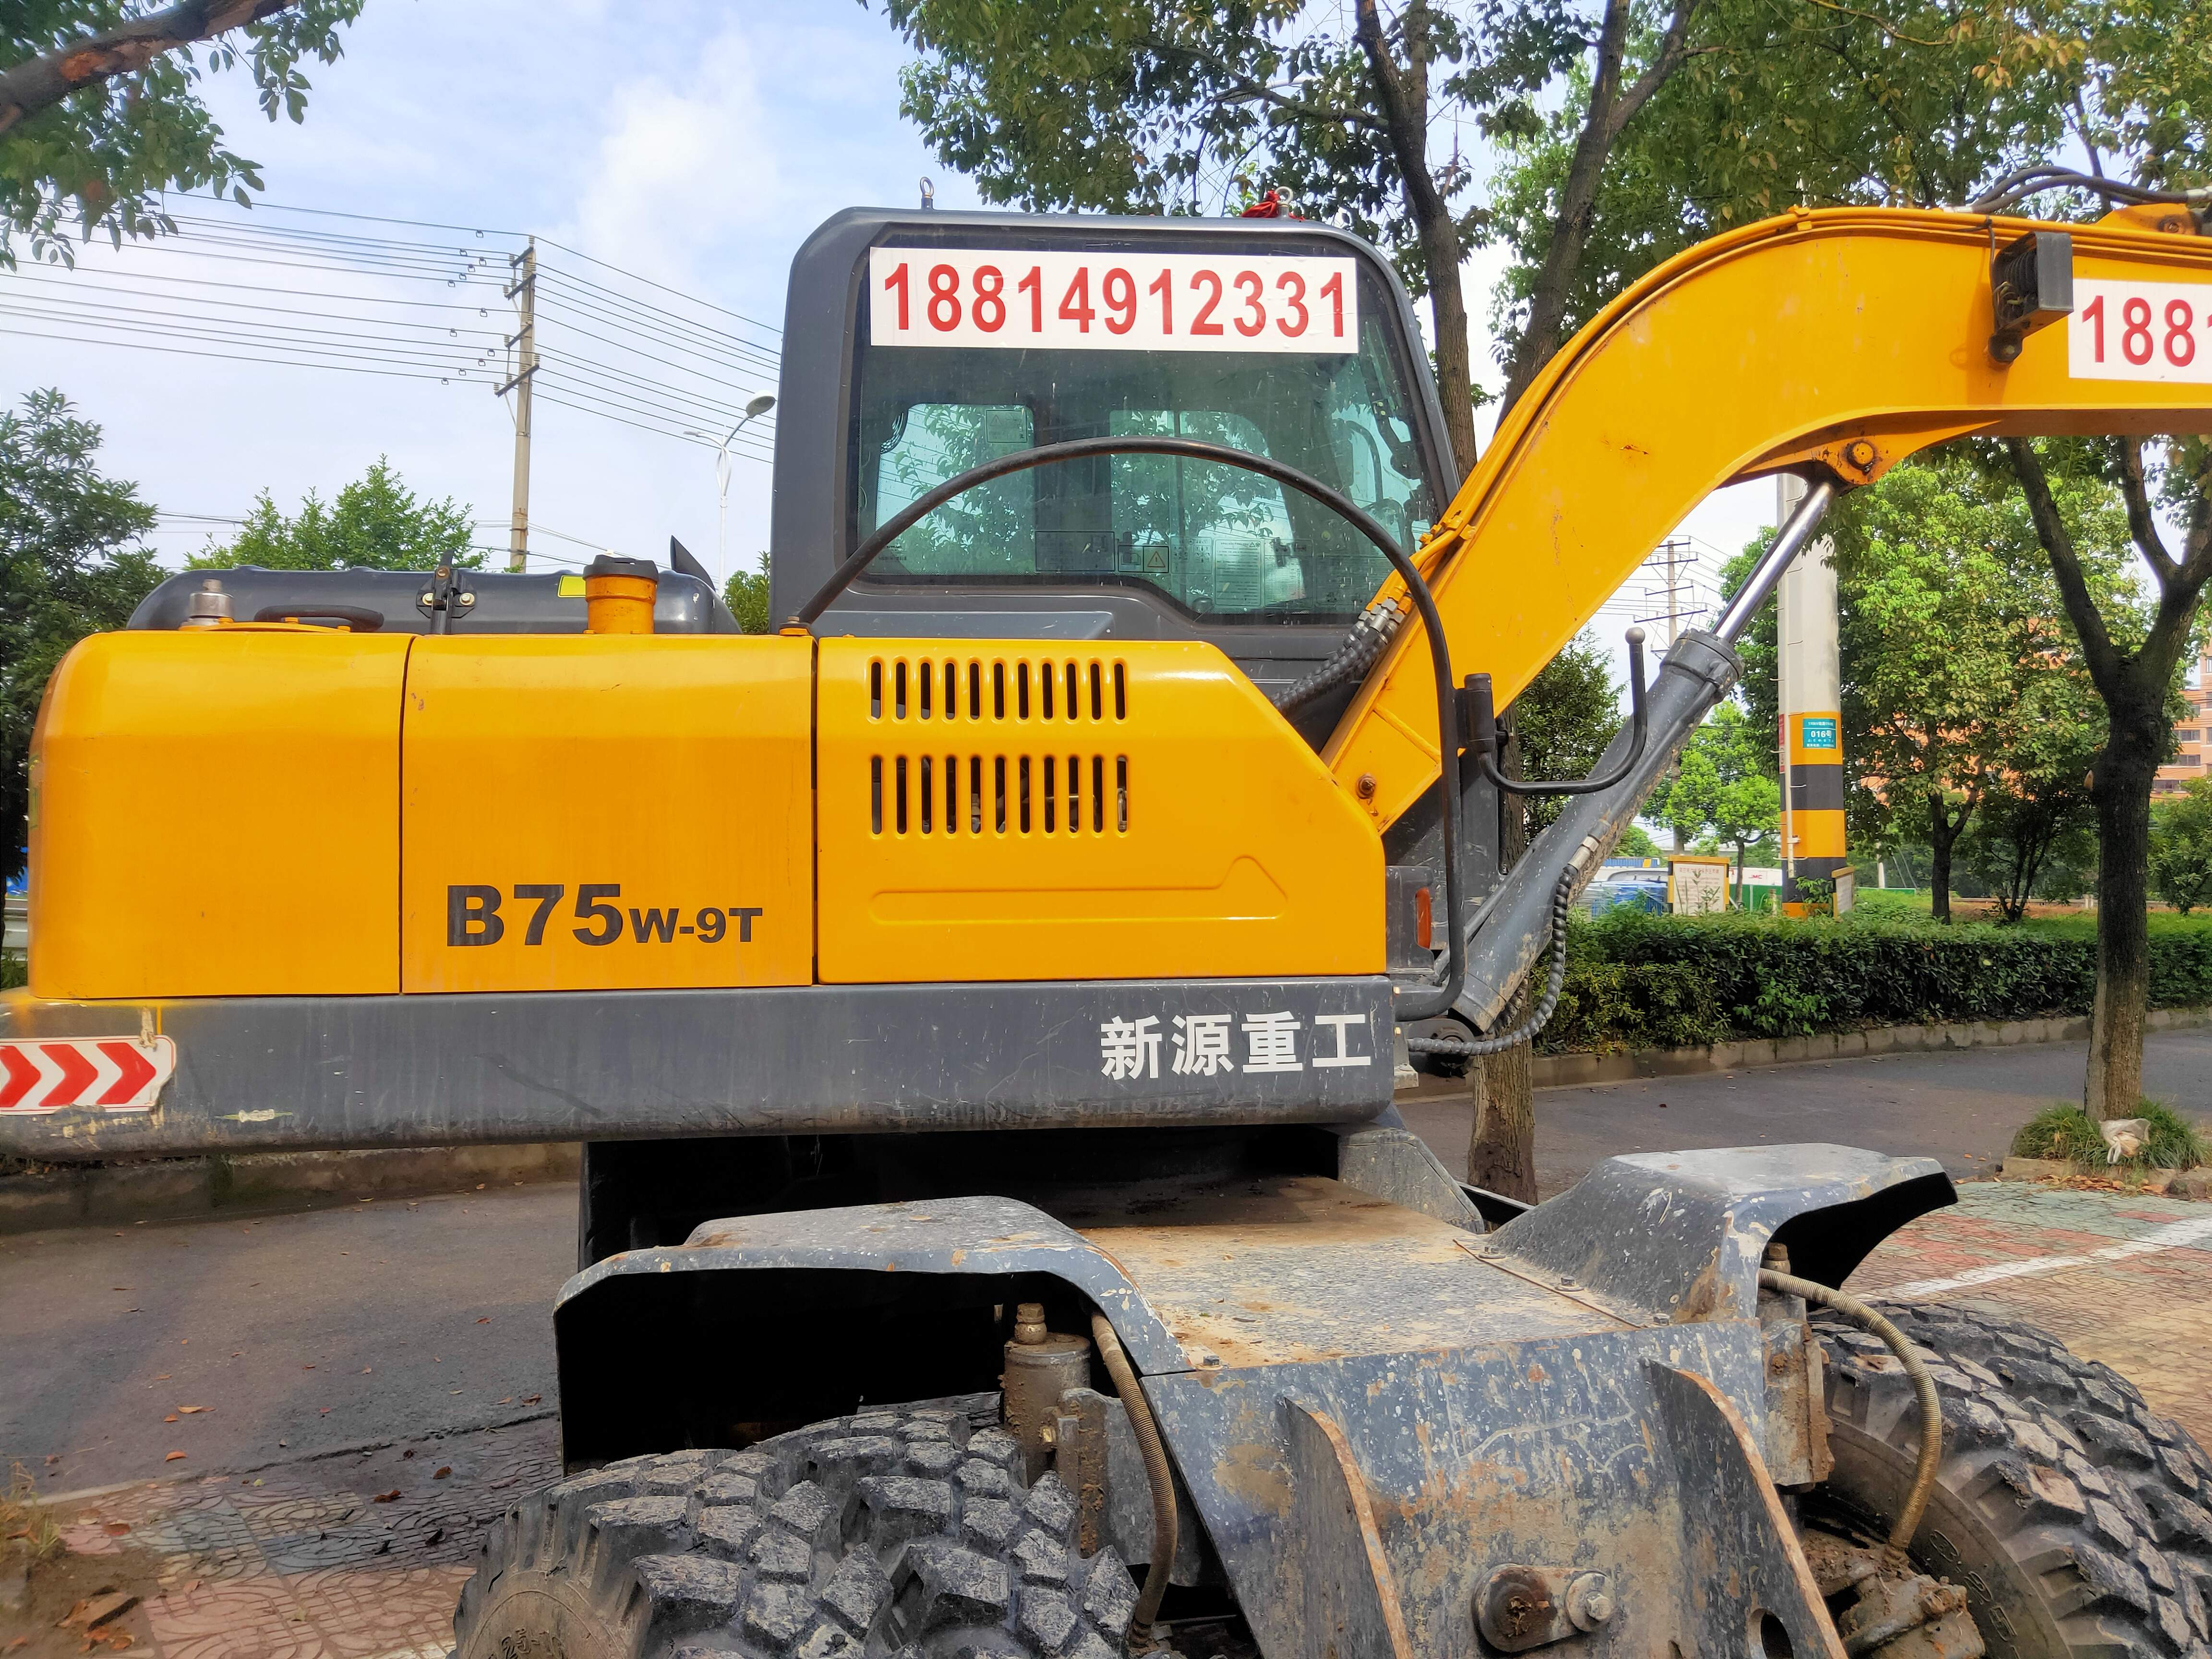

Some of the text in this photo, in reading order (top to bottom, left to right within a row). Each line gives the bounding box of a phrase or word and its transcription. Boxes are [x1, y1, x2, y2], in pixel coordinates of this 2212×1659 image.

[885, 263, 1344, 337] 18814912331
[2082, 295, 2212, 367] 188
[1100, 1011, 1371, 1080] 新源重工
